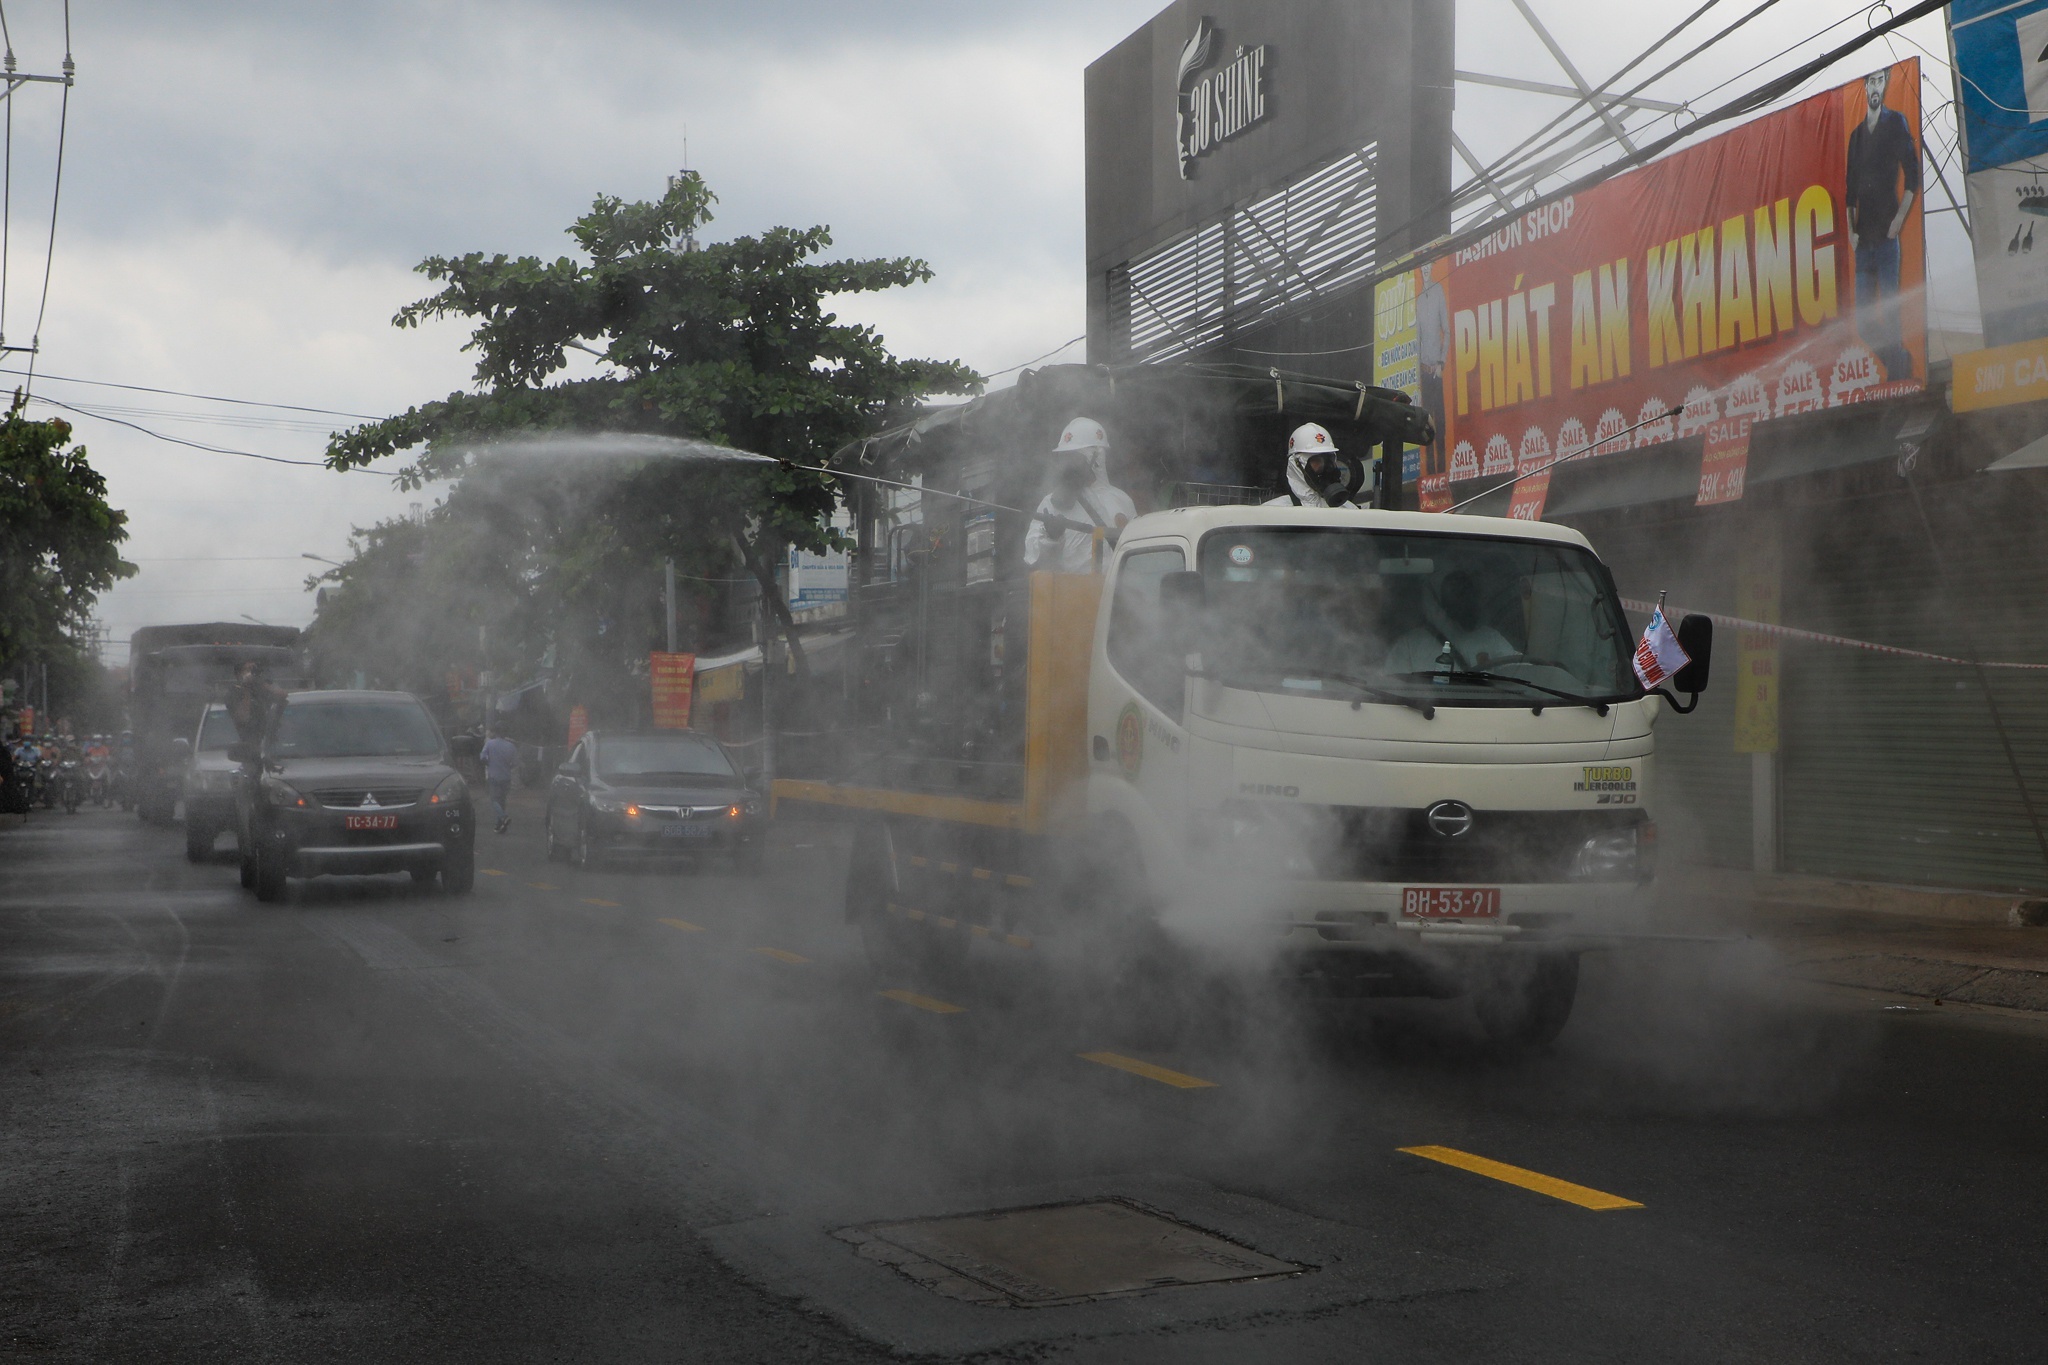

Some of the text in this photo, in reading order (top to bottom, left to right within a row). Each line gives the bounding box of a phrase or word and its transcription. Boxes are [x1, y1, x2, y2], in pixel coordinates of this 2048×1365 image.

[1190, 45, 1265, 157] 30 SHINE
[1455, 195, 1575, 267] FASHION SHOP
[1454, 185, 1838, 416] PHÁT AN KHANG
[1838, 357, 1870, 383] SALE
[1783, 371, 1812, 395] SALE
[1733, 384, 1760, 408] SALE
[1685, 399, 1711, 419] SALE
[1562, 427, 1583, 448] SALE
[1601, 418, 1622, 439] SALE
[1709, 418, 1749, 444] SALE
[1488, 442, 1508, 462] SALE
[1525, 435, 1545, 455] SALE
[1455, 450, 1473, 468] SALE
[1421, 477, 1447, 494] SALE
[1697, 471, 1721, 502] 59K
[1726, 466, 1746, 498] 99K
[1240, 783, 1300, 798] HINO
[1583, 766, 1633, 791] TURBO
[1405, 890, 1493, 914] BH-53-91
